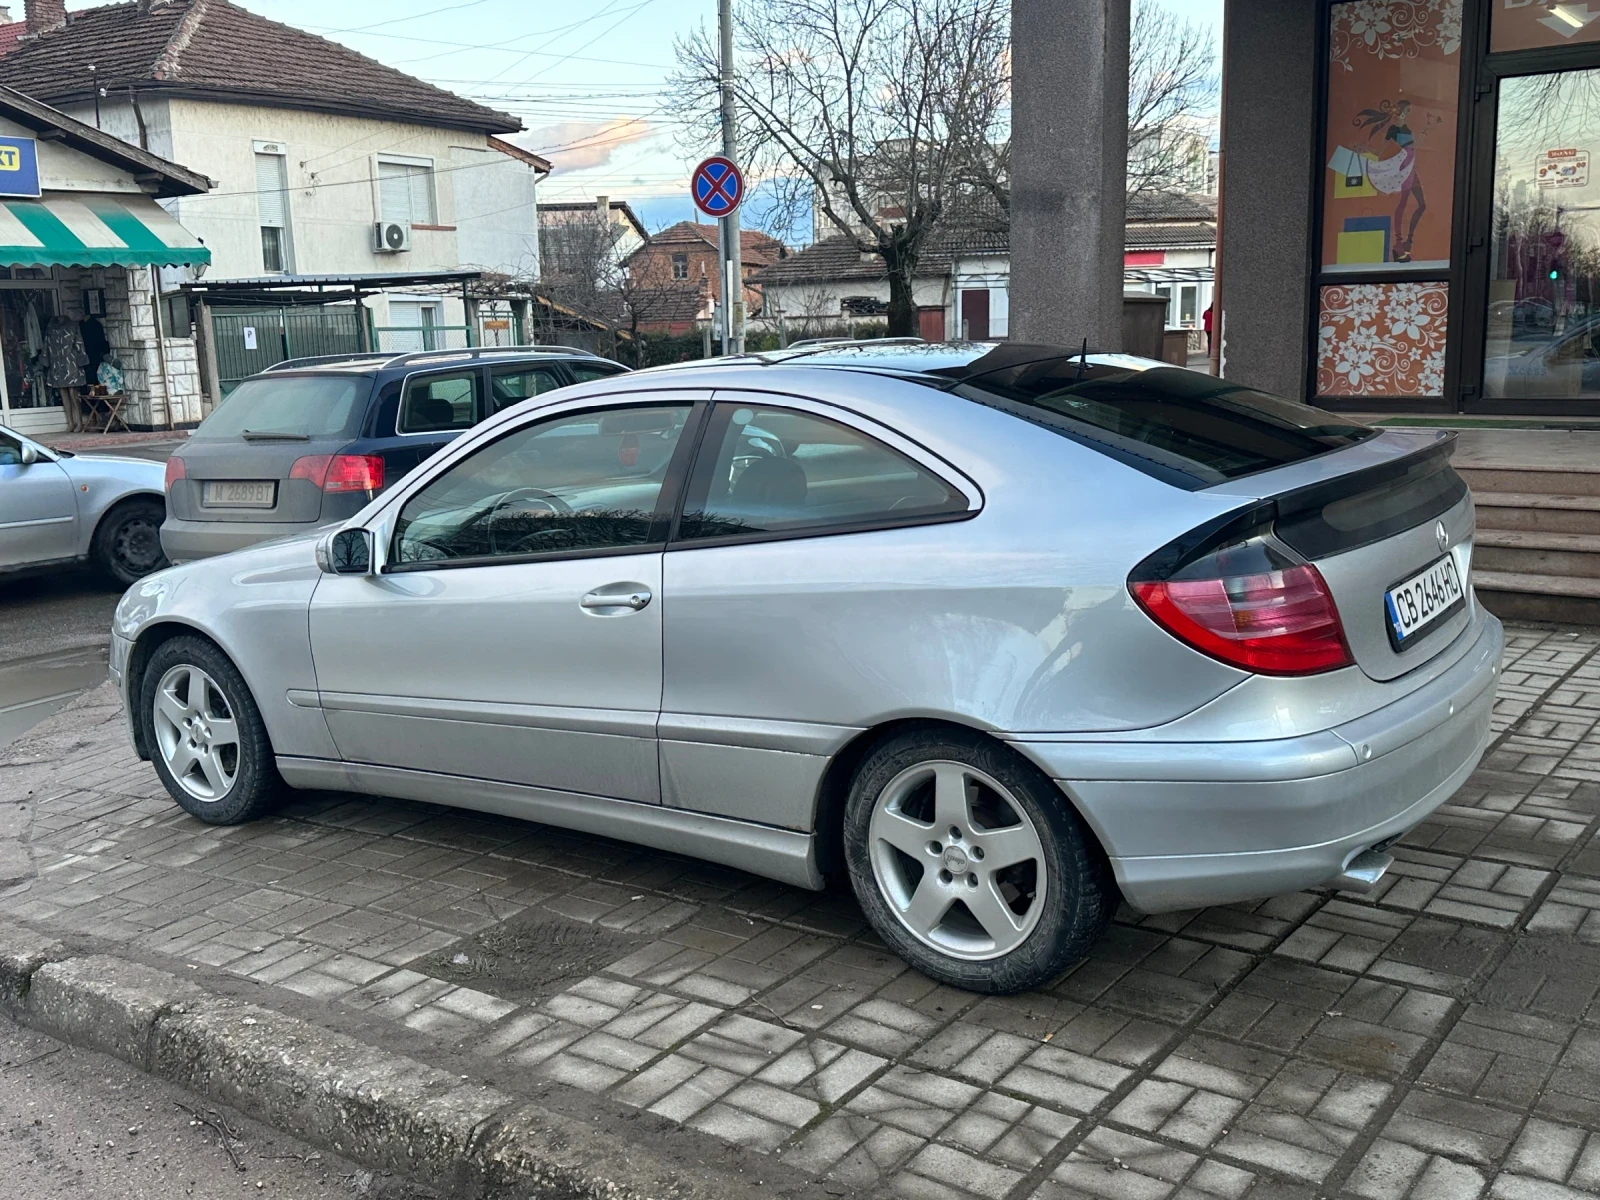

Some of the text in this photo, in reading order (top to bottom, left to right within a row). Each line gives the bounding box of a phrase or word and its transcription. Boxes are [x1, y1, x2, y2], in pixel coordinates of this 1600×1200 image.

[228, 484, 254, 501] 2689
[1396, 562, 1458, 628] CB 2646 HC
